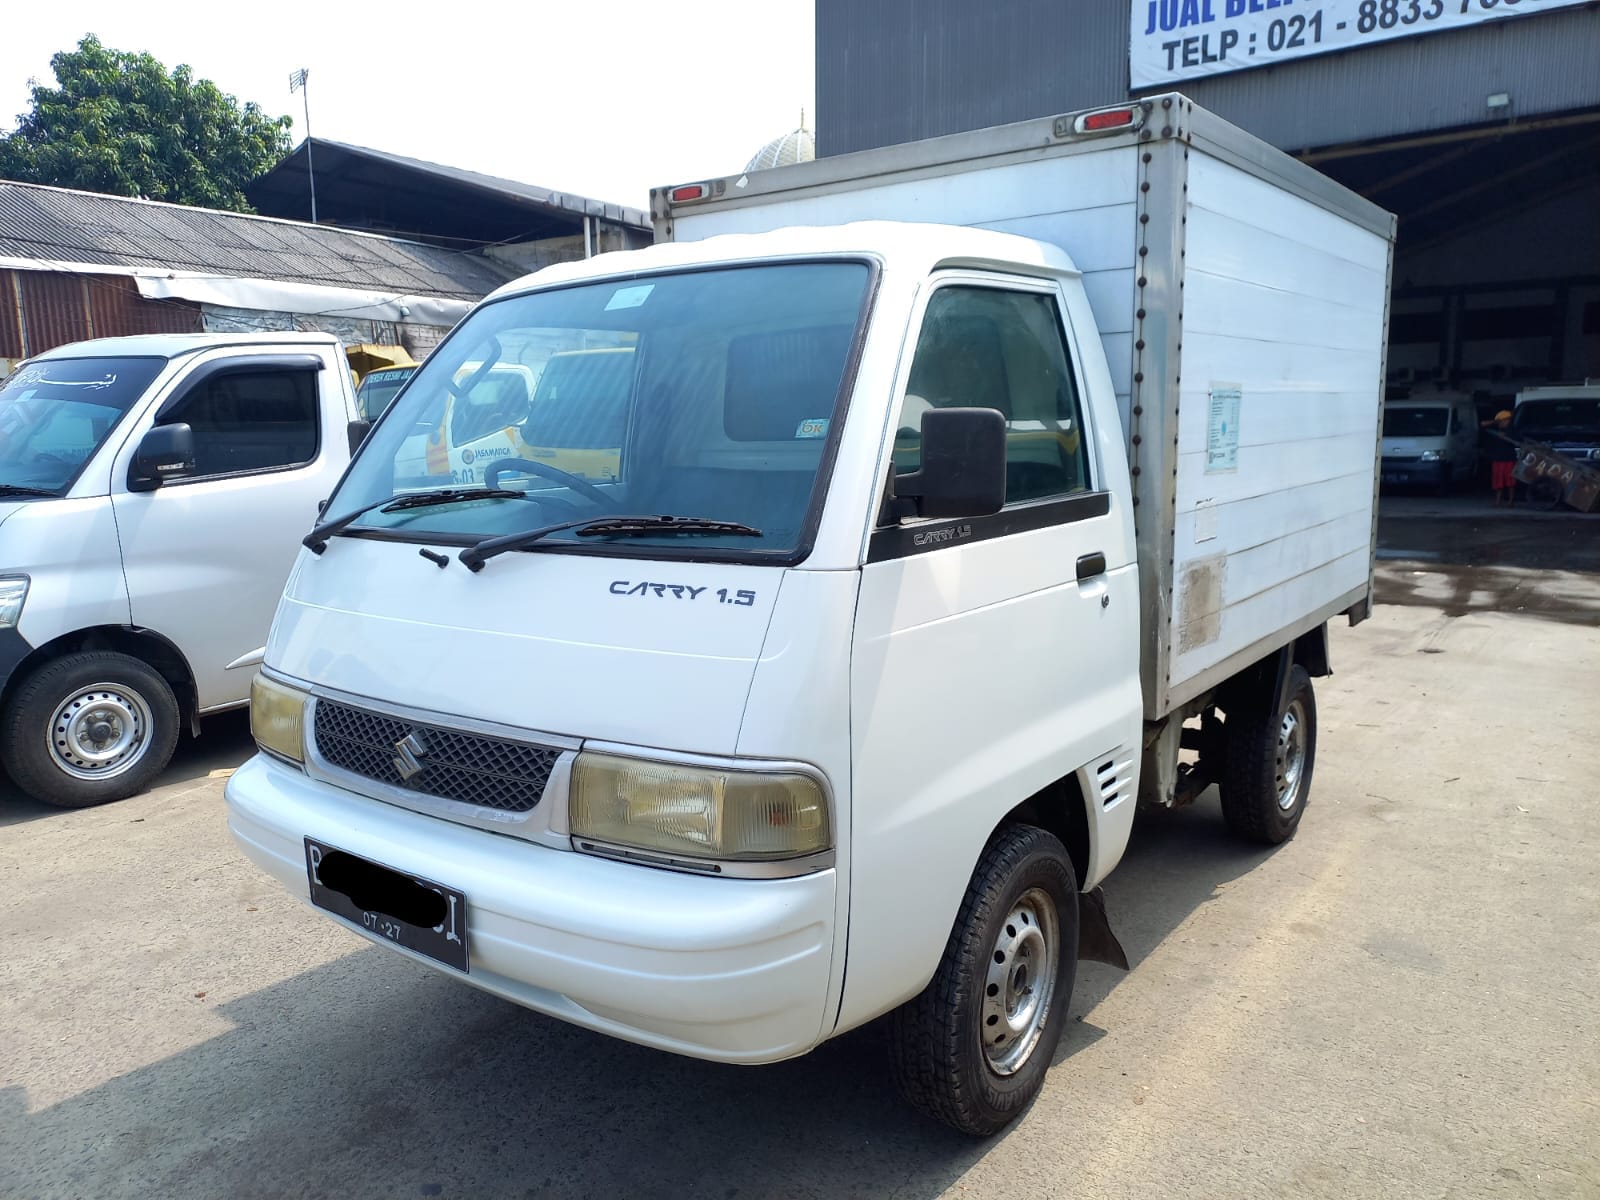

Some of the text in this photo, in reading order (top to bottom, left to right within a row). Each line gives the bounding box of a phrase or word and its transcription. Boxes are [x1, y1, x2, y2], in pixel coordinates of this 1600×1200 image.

[1162, 29, 1239, 71] TELP
[1267, 9, 1323, 52] 021
[914, 527, 955, 546] CARRY
[609, 581, 756, 607] CARRY 1.5
